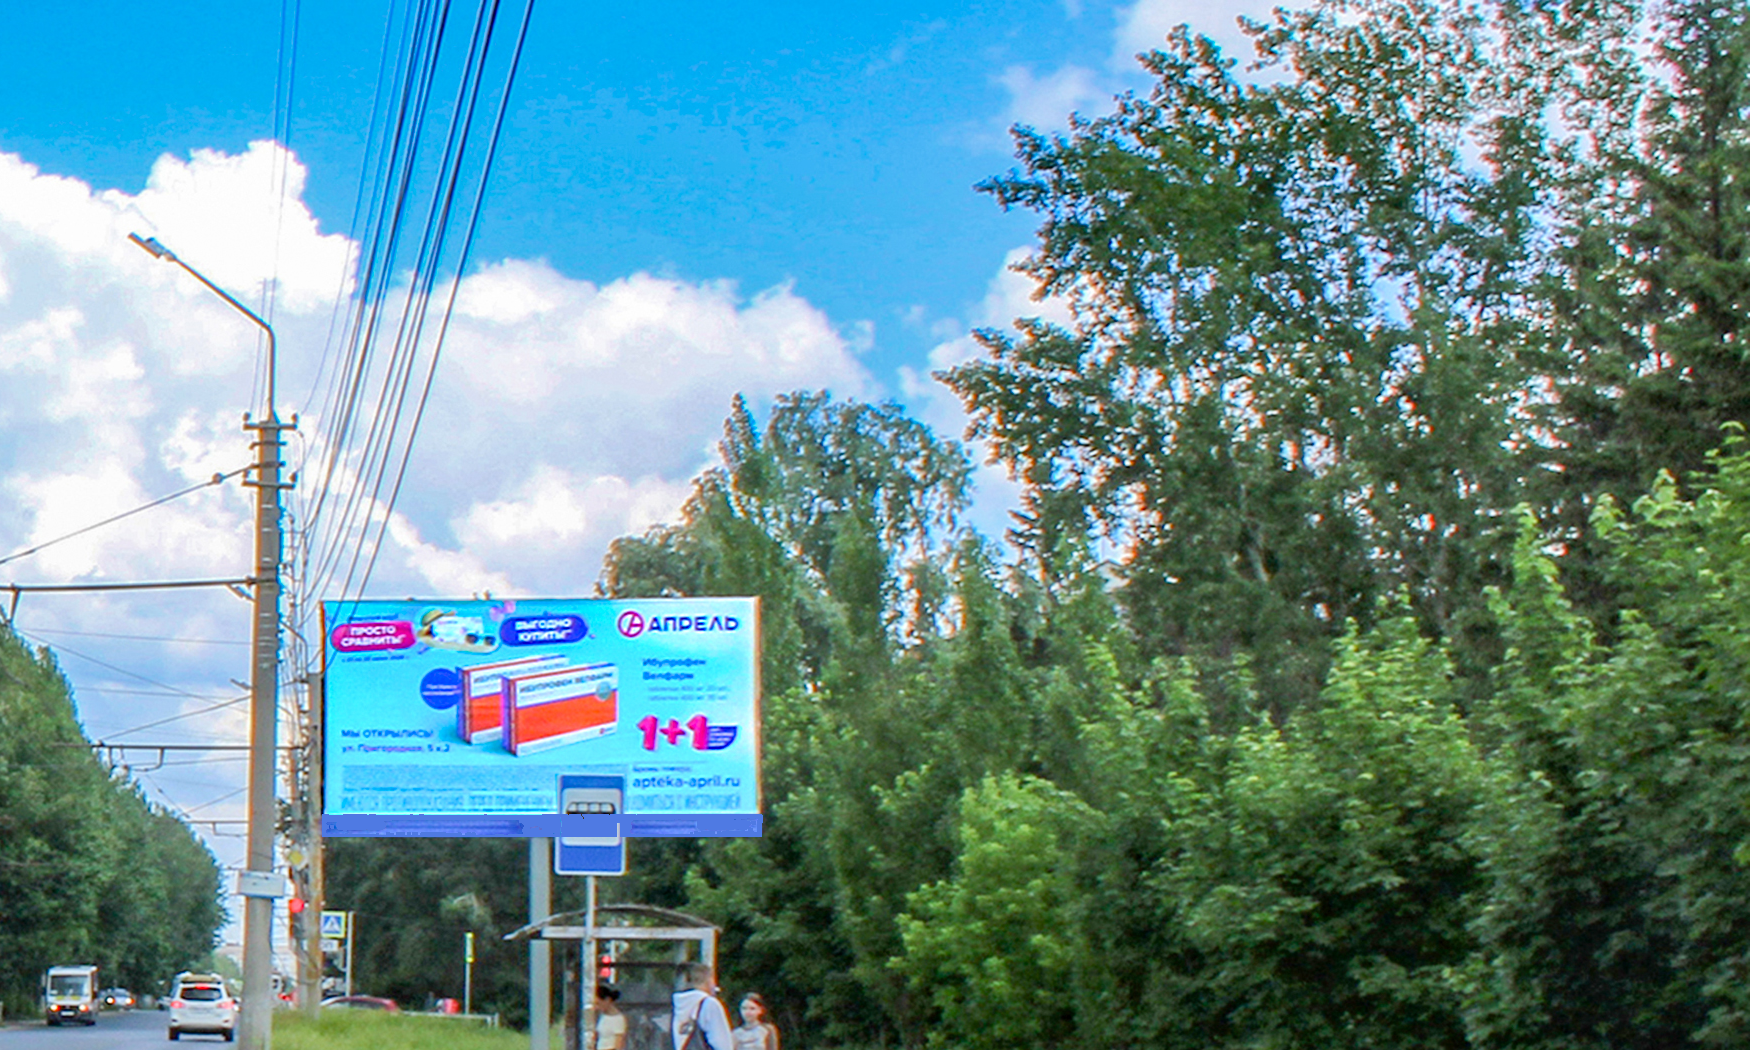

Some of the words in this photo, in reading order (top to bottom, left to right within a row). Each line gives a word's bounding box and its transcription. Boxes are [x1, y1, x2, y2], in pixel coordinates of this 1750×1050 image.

[350, 625, 397, 636] ПРОСТО
[515, 618, 572, 630] ВЫГОДНО
[647, 616, 739, 632] АПРЕЛЬ
[637, 714, 708, 751] 1+1
[632, 775, 740, 789] apteka-april.ru
